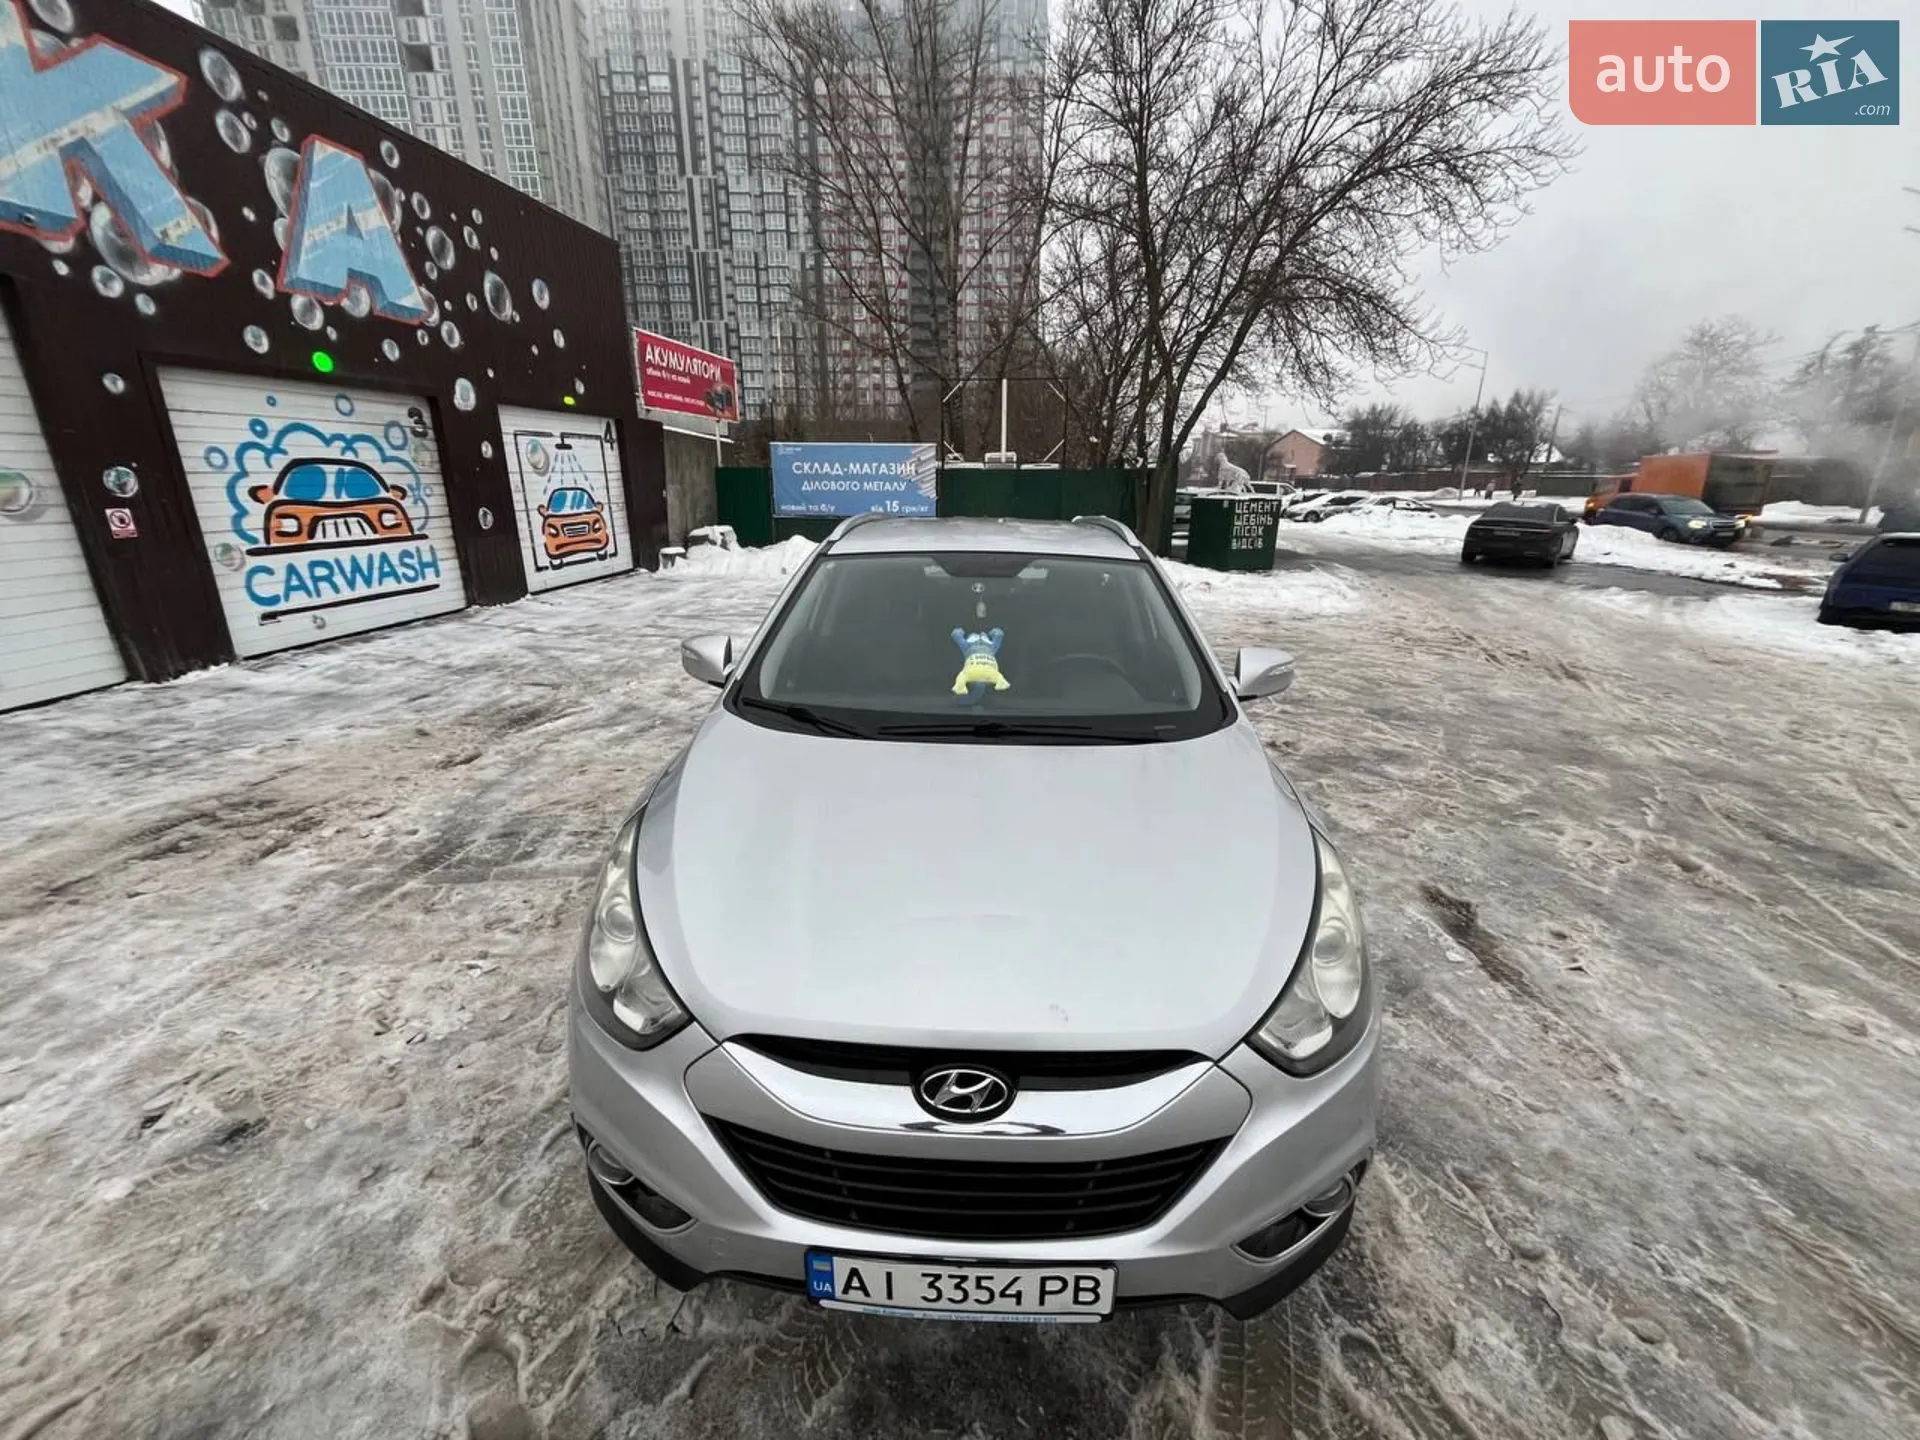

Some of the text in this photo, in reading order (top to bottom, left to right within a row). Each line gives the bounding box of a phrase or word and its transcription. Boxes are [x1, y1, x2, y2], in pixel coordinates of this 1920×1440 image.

[645, 343, 721, 381] АКУМУЛЯТОРИ
[407, 407, 429, 439] 3
[603, 420, 616, 451] 4
[791, 461, 917, 476] СКЛАД-МАГАЗИН
[801, 480, 907, 492] ДІЛОВОГО МЕТАЛУ
[885, 501, 899, 512] 15
[1235, 501, 1279, 514] ЦЕМЕНТ
[1232, 525, 1264, 537] ПІСОК
[244, 544, 440, 607] CARWASH
[813, 1280, 833, 1293] UA
[841, 1266, 1102, 1307] AI 3354 PB
